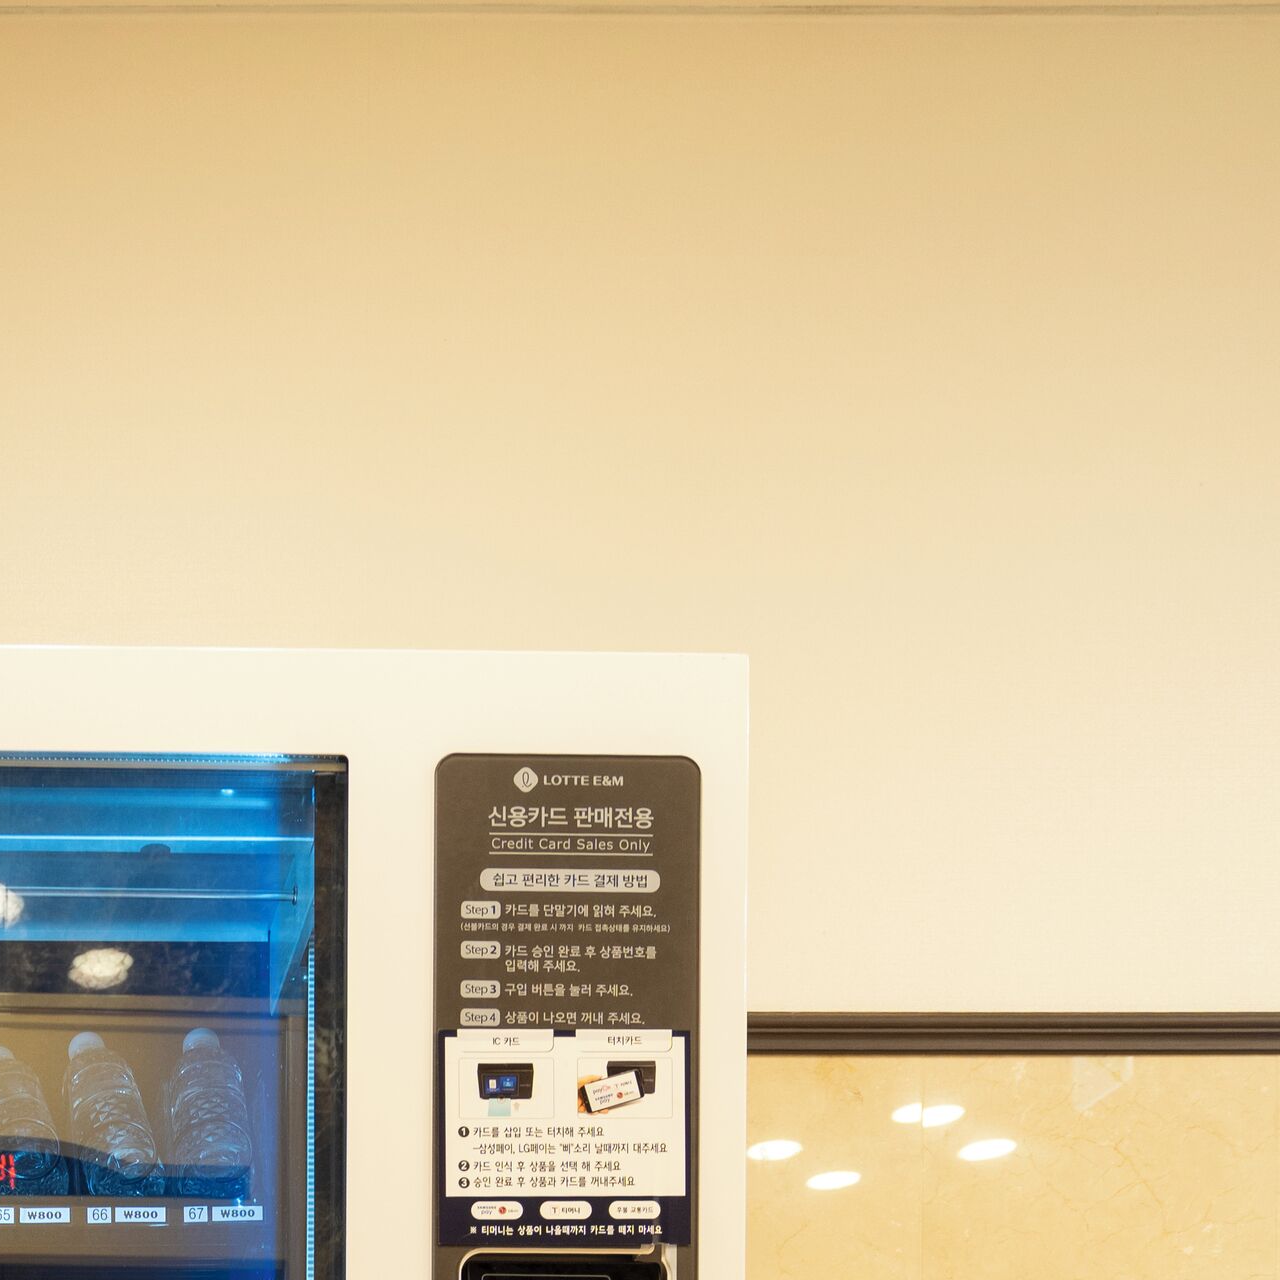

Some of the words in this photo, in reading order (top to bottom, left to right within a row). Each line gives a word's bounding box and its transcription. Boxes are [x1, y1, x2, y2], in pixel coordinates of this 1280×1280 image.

[543, 775, 590, 786] LOTTE
[593, 776, 624, 786] E&M
[489, 806, 568, 828] 신용카드
[574, 807, 654, 828] 판매전용
[491, 837, 534, 850] Credit
[539, 838, 571, 850] Card
[577, 838, 613, 850] Sales
[619, 839, 650, 853] Only
[493, 873, 518, 886] 쉽고
[522, 873, 560, 887] 편리한
[564, 874, 589, 887] 카드
[594, 874, 619, 887] 결제
[623, 875, 648, 888] 방법
[465, 905, 488, 916] Step
[491, 905, 496, 914] 1
[505, 905, 539, 916] 카드를
[544, 905, 589, 917] 단말기에
[593, 906, 615, 918] 읽혀
[619, 906, 656, 917] 주세요.
[465, 985, 488, 996] Step
[490, 985, 496, 994] 3
[505, 983, 527, 996] 구입
[532, 984, 565, 996] 버튼을
[569, 984, 592, 997] 눌러
[596, 984, 633, 996] 주세요.
[465, 1013, 488, 1024] Step
[489, 1014, 496, 1022] 4
[505, 1011, 539, 1024] 상품이
[543, 1012, 577, 1024] 나오면
[581, 1012, 603, 1024] 꺼내
[607, 1012, 645, 1024] 주세요.
[188, 1207, 204, 1220] 67
